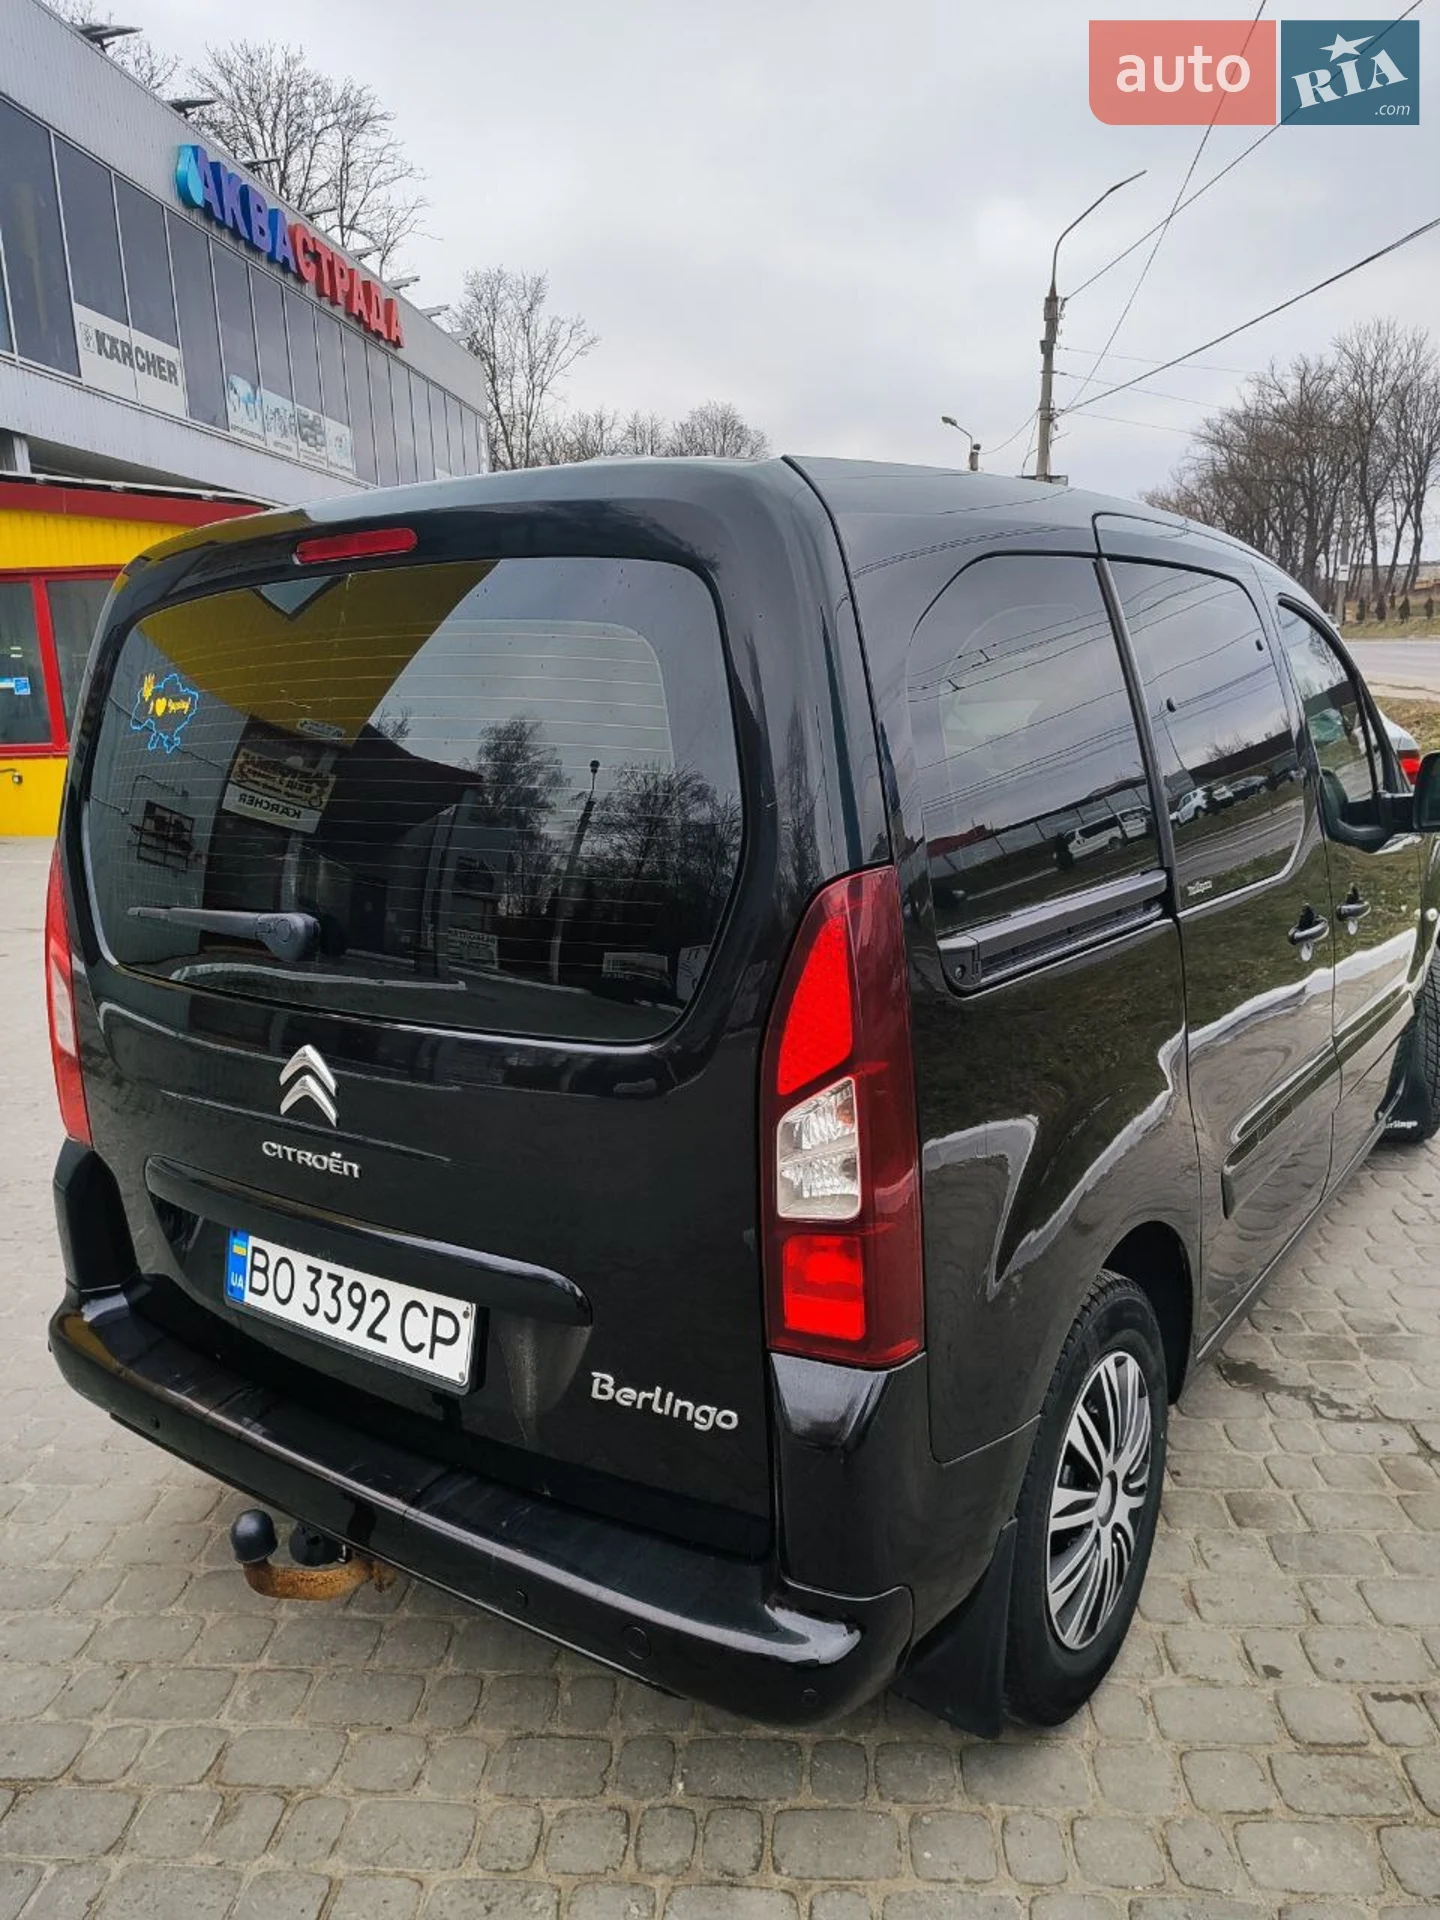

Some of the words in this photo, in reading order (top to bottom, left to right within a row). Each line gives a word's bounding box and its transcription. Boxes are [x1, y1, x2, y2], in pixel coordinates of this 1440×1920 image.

[184, 145, 404, 348] АКВАСТРАДА
[230, 1271, 244, 1290] UA
[249, 1246, 295, 1306] BO
[303, 1265, 391, 1344] 3392
[400, 1300, 461, 1360] CP
[591, 1371, 739, 1432] Berlingo
